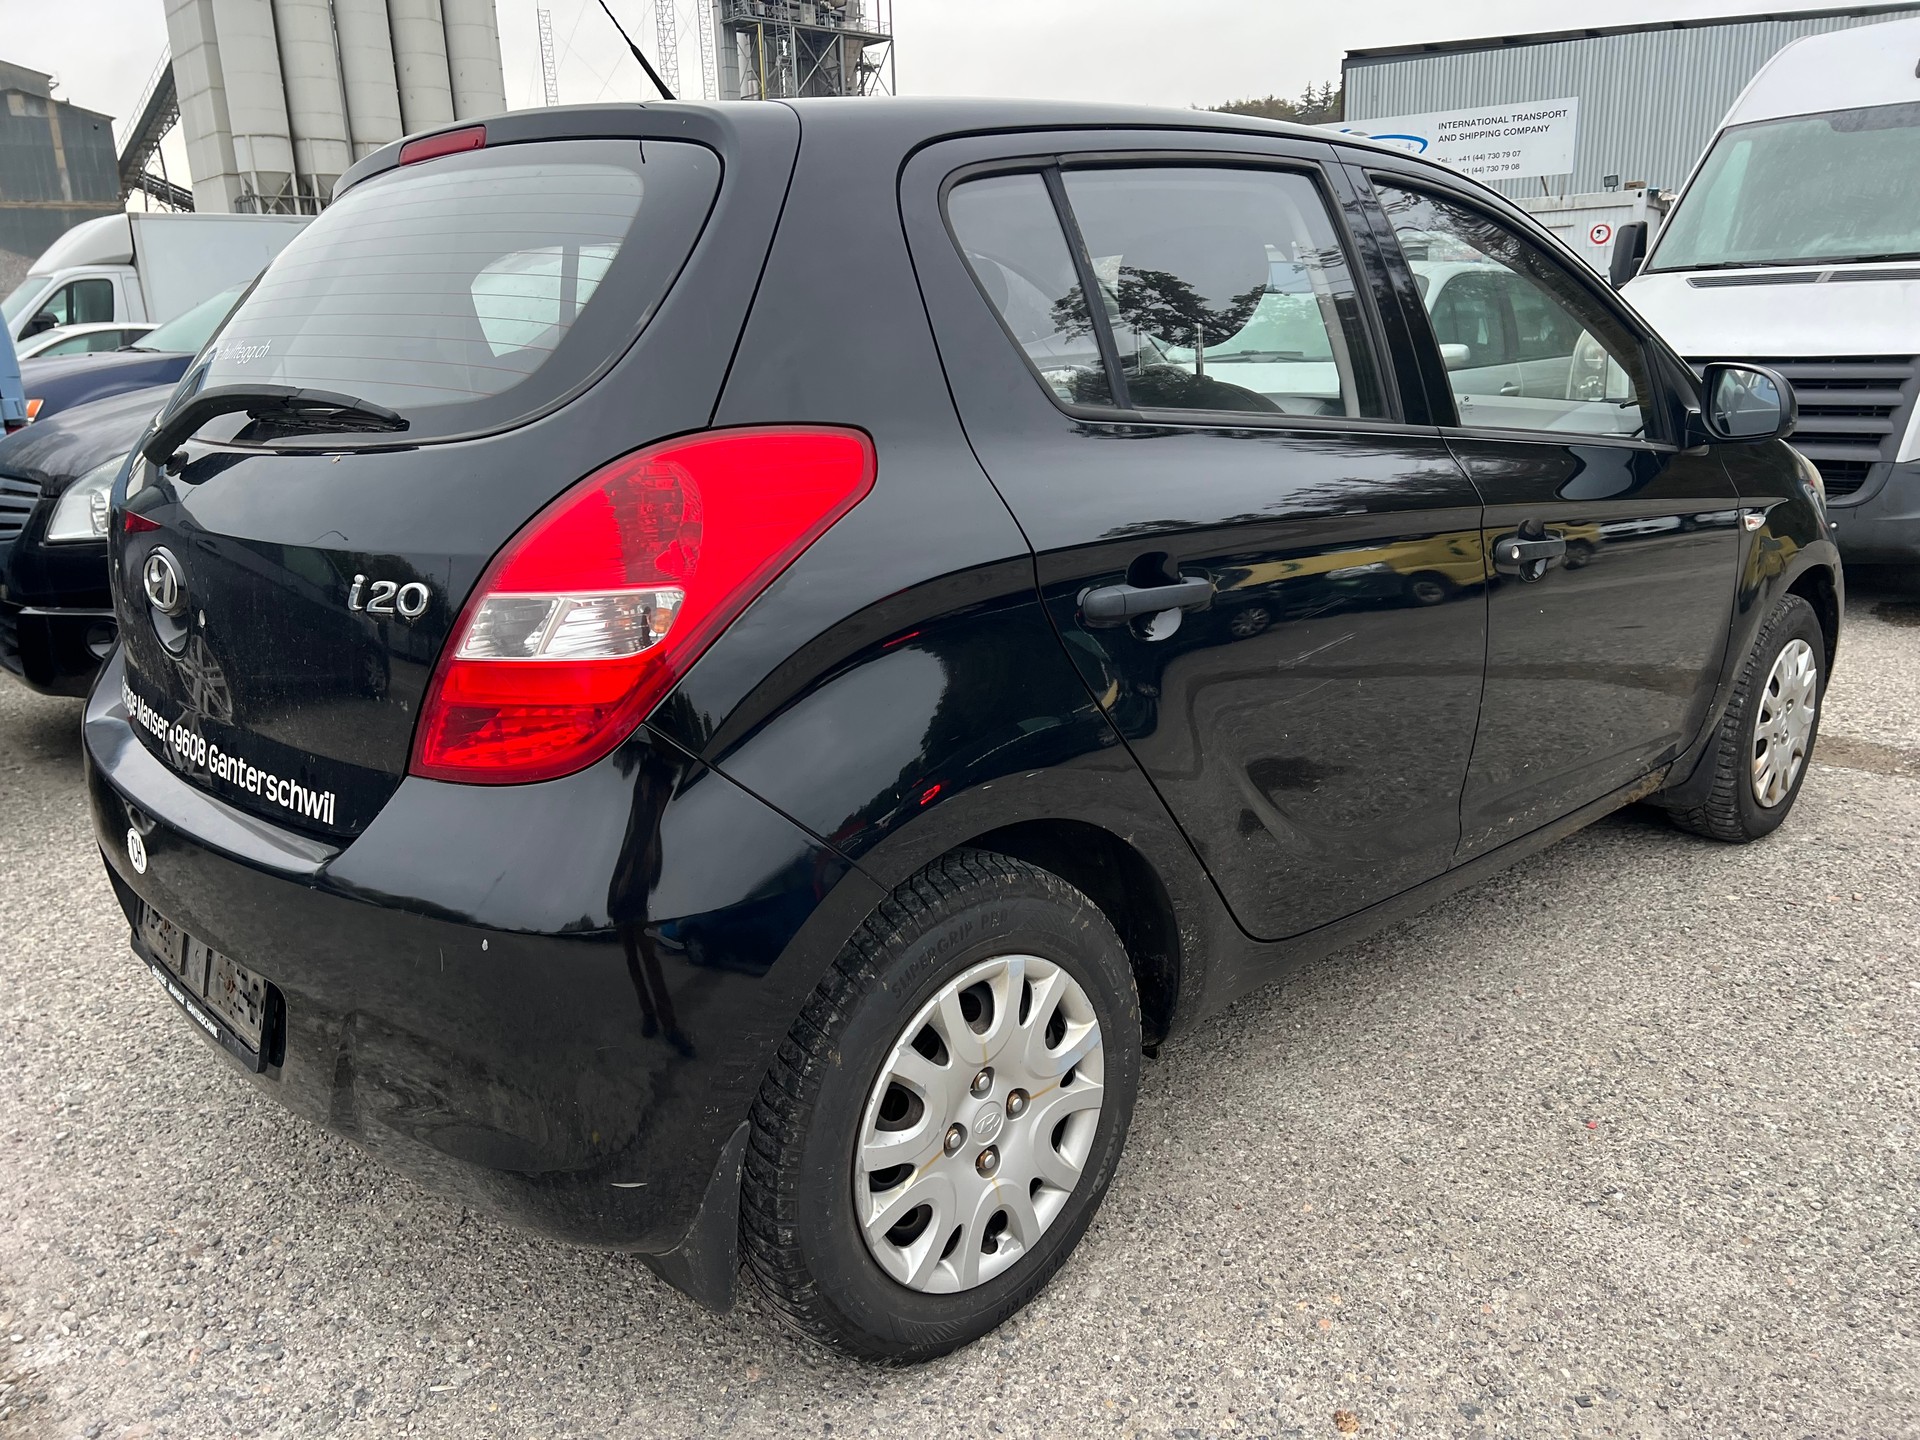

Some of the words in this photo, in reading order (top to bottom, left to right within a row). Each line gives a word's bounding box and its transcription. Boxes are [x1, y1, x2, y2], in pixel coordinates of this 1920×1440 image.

[1437, 133, 1457, 144] AND
[1458, 129, 1501, 142] SHIPPING
[1503, 124, 1551, 138] COMPANY
[1438, 116, 1509, 130] INTERNATIONAL
[1511, 109, 1568, 123] TRANSPORT
[1458, 154, 1471, 163] +41
[1472, 153, 1486, 162] (44)
[1487, 151, 1501, 160] 730
[1501, 150, 1511, 159] 79
[1511, 149, 1522, 158] 07
[1471, 166, 1485, 175] (44)
[1486, 164, 1500, 173] 730
[1500, 163, 1510, 172] 79
[1510, 162, 1521, 171] 08
[348, 573, 430, 617] i20
[136, 694, 170, 742] Manser
[174, 724, 207, 767] 9608
[208, 744, 335, 825] Ganterschwil
[130, 835, 145, 868] CH
[889, 919, 974, 1001] SUPERGRIP
[152, 964, 167, 987] GARAGE
[168, 982, 185, 1005] MANSER
